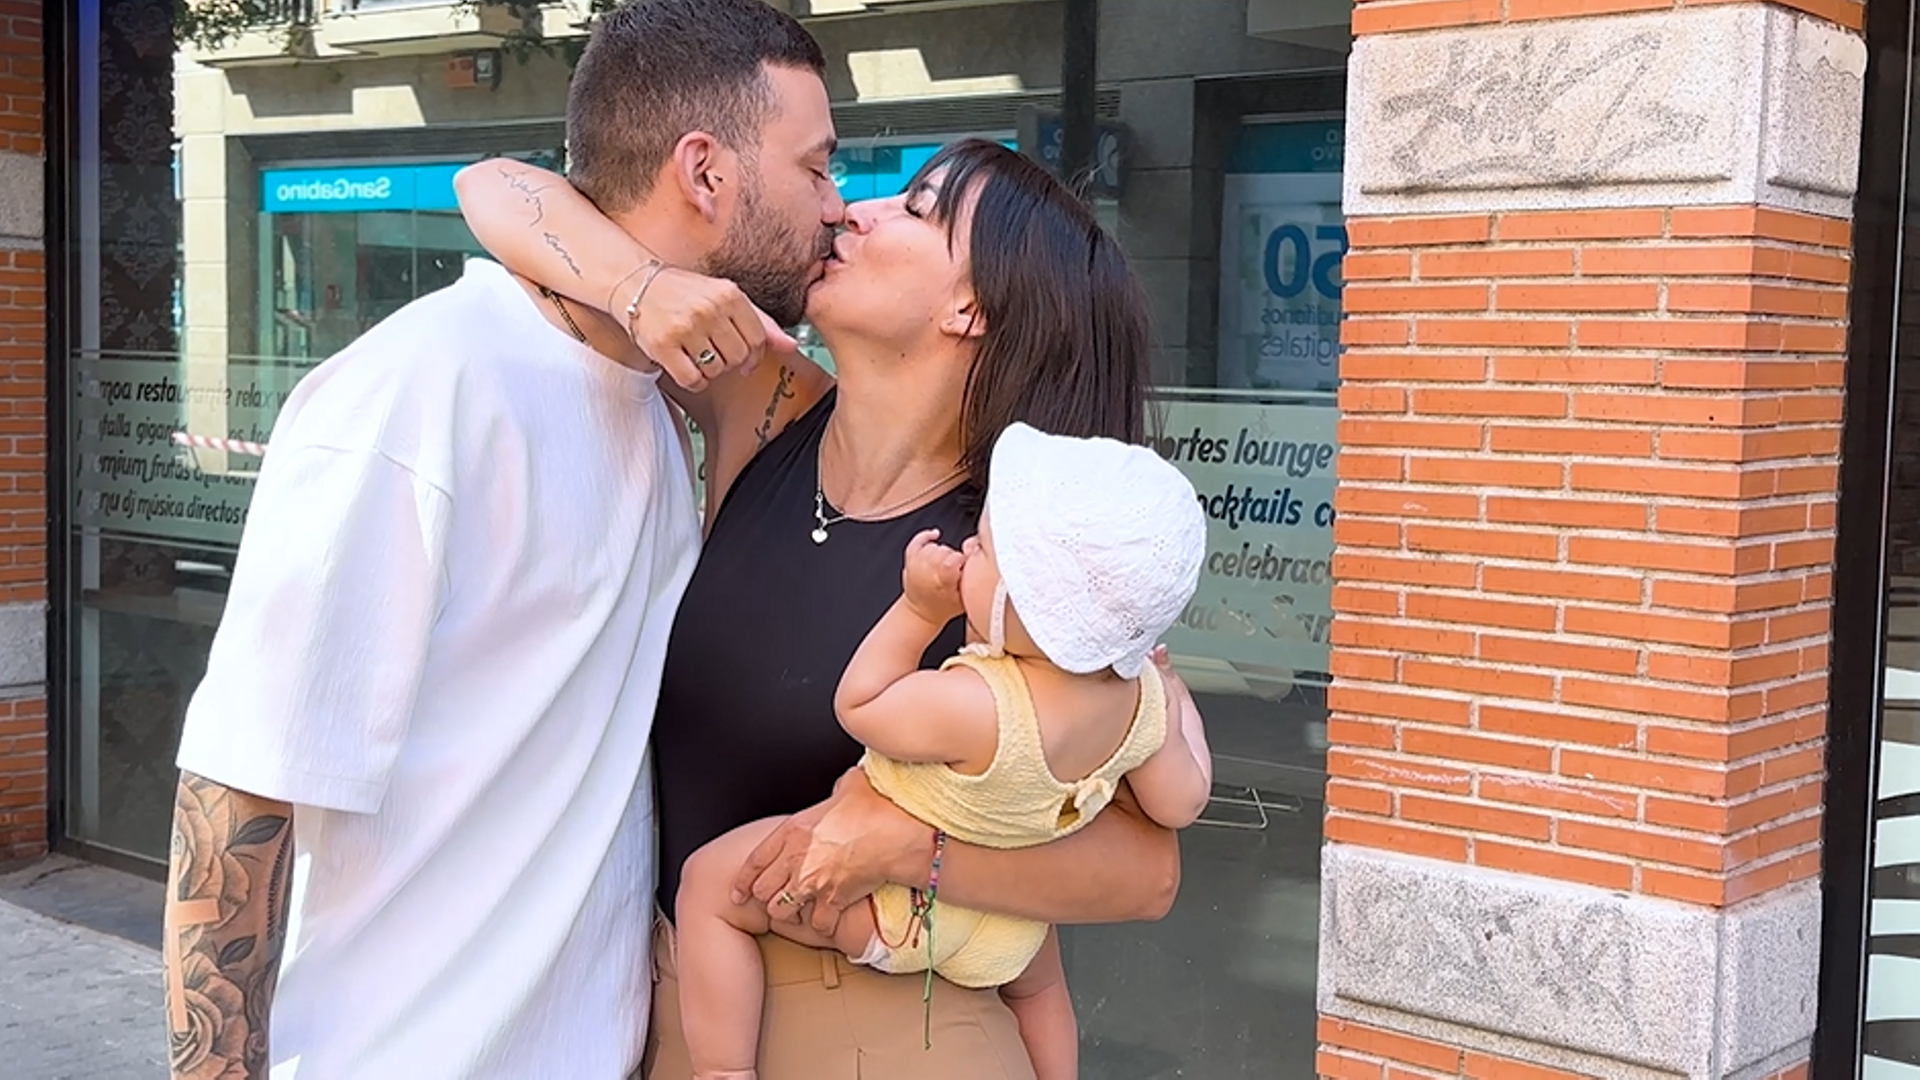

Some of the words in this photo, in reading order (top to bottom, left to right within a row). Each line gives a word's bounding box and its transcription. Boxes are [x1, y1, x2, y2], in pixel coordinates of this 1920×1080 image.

[1232, 427, 1334, 478] lounge
[121, 488, 138, 519] dj
[185, 493, 241, 525] directos
[1208, 541, 1332, 586] celebrac
